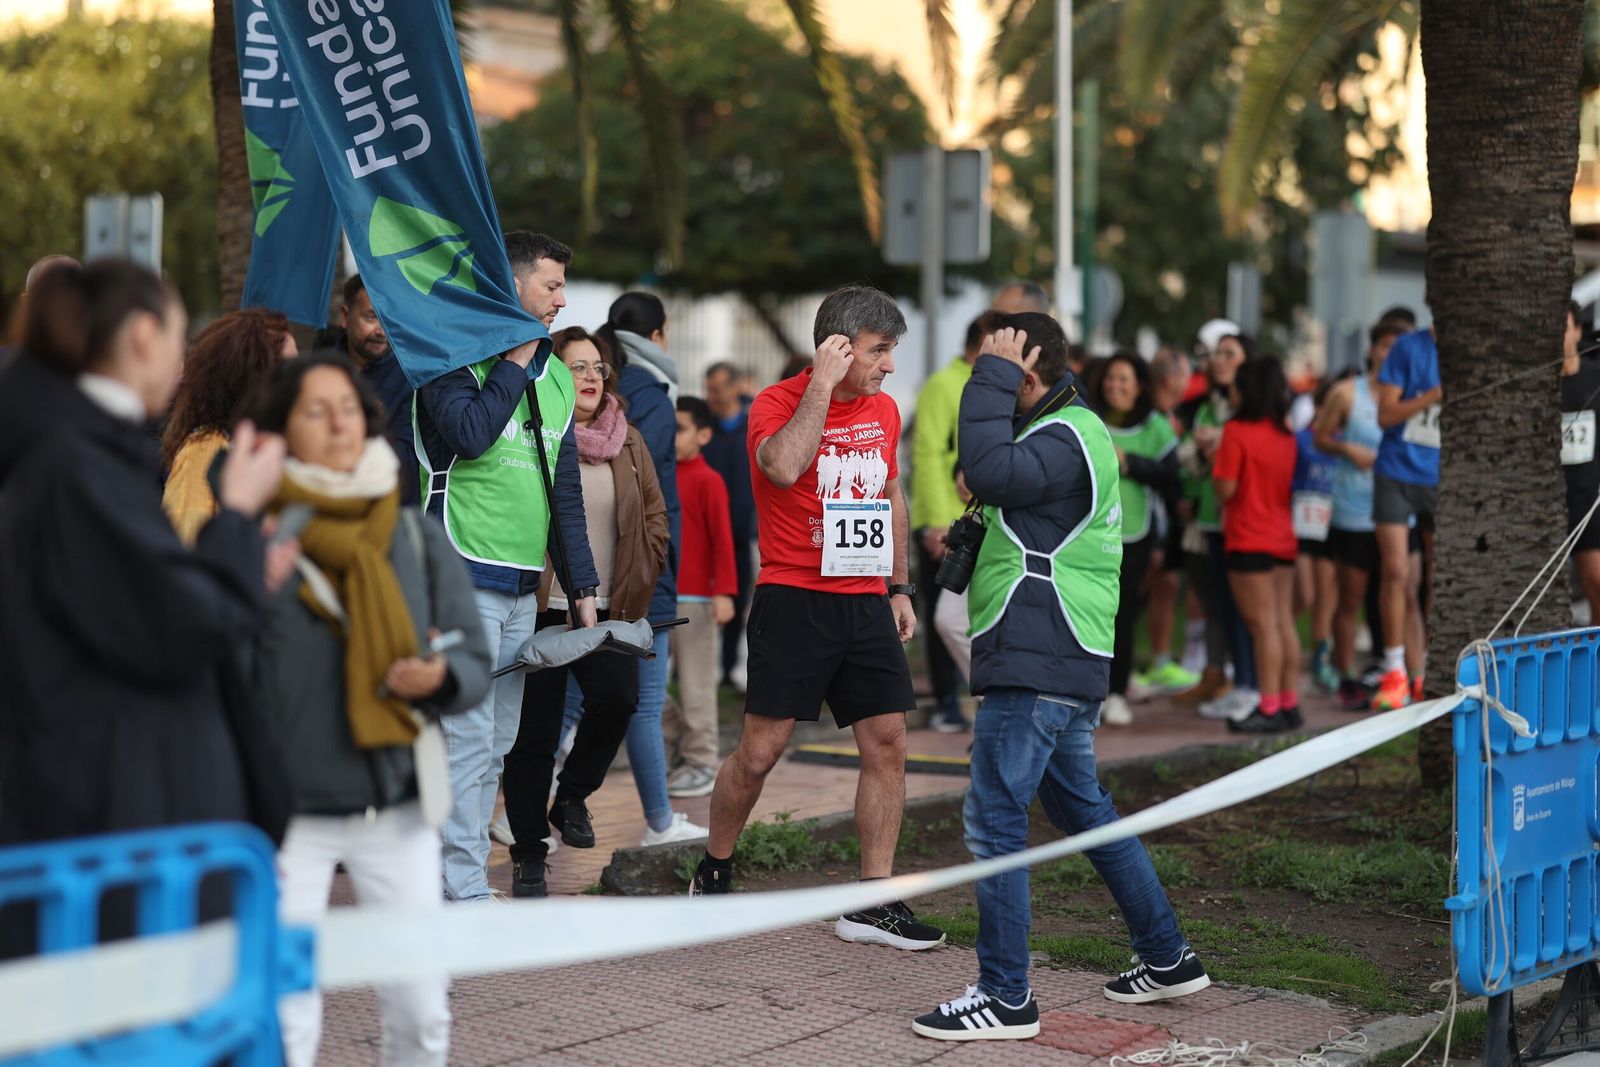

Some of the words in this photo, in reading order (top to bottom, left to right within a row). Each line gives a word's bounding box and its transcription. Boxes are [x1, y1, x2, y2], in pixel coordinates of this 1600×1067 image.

[241, 0, 278, 108] Fun
[822, 427, 851, 437] CARRERA
[850, 423, 873, 431] URBANA
[872, 420, 880, 428] DE
[853, 427, 885, 441] JARDÍN
[835, 518, 884, 549] 158
